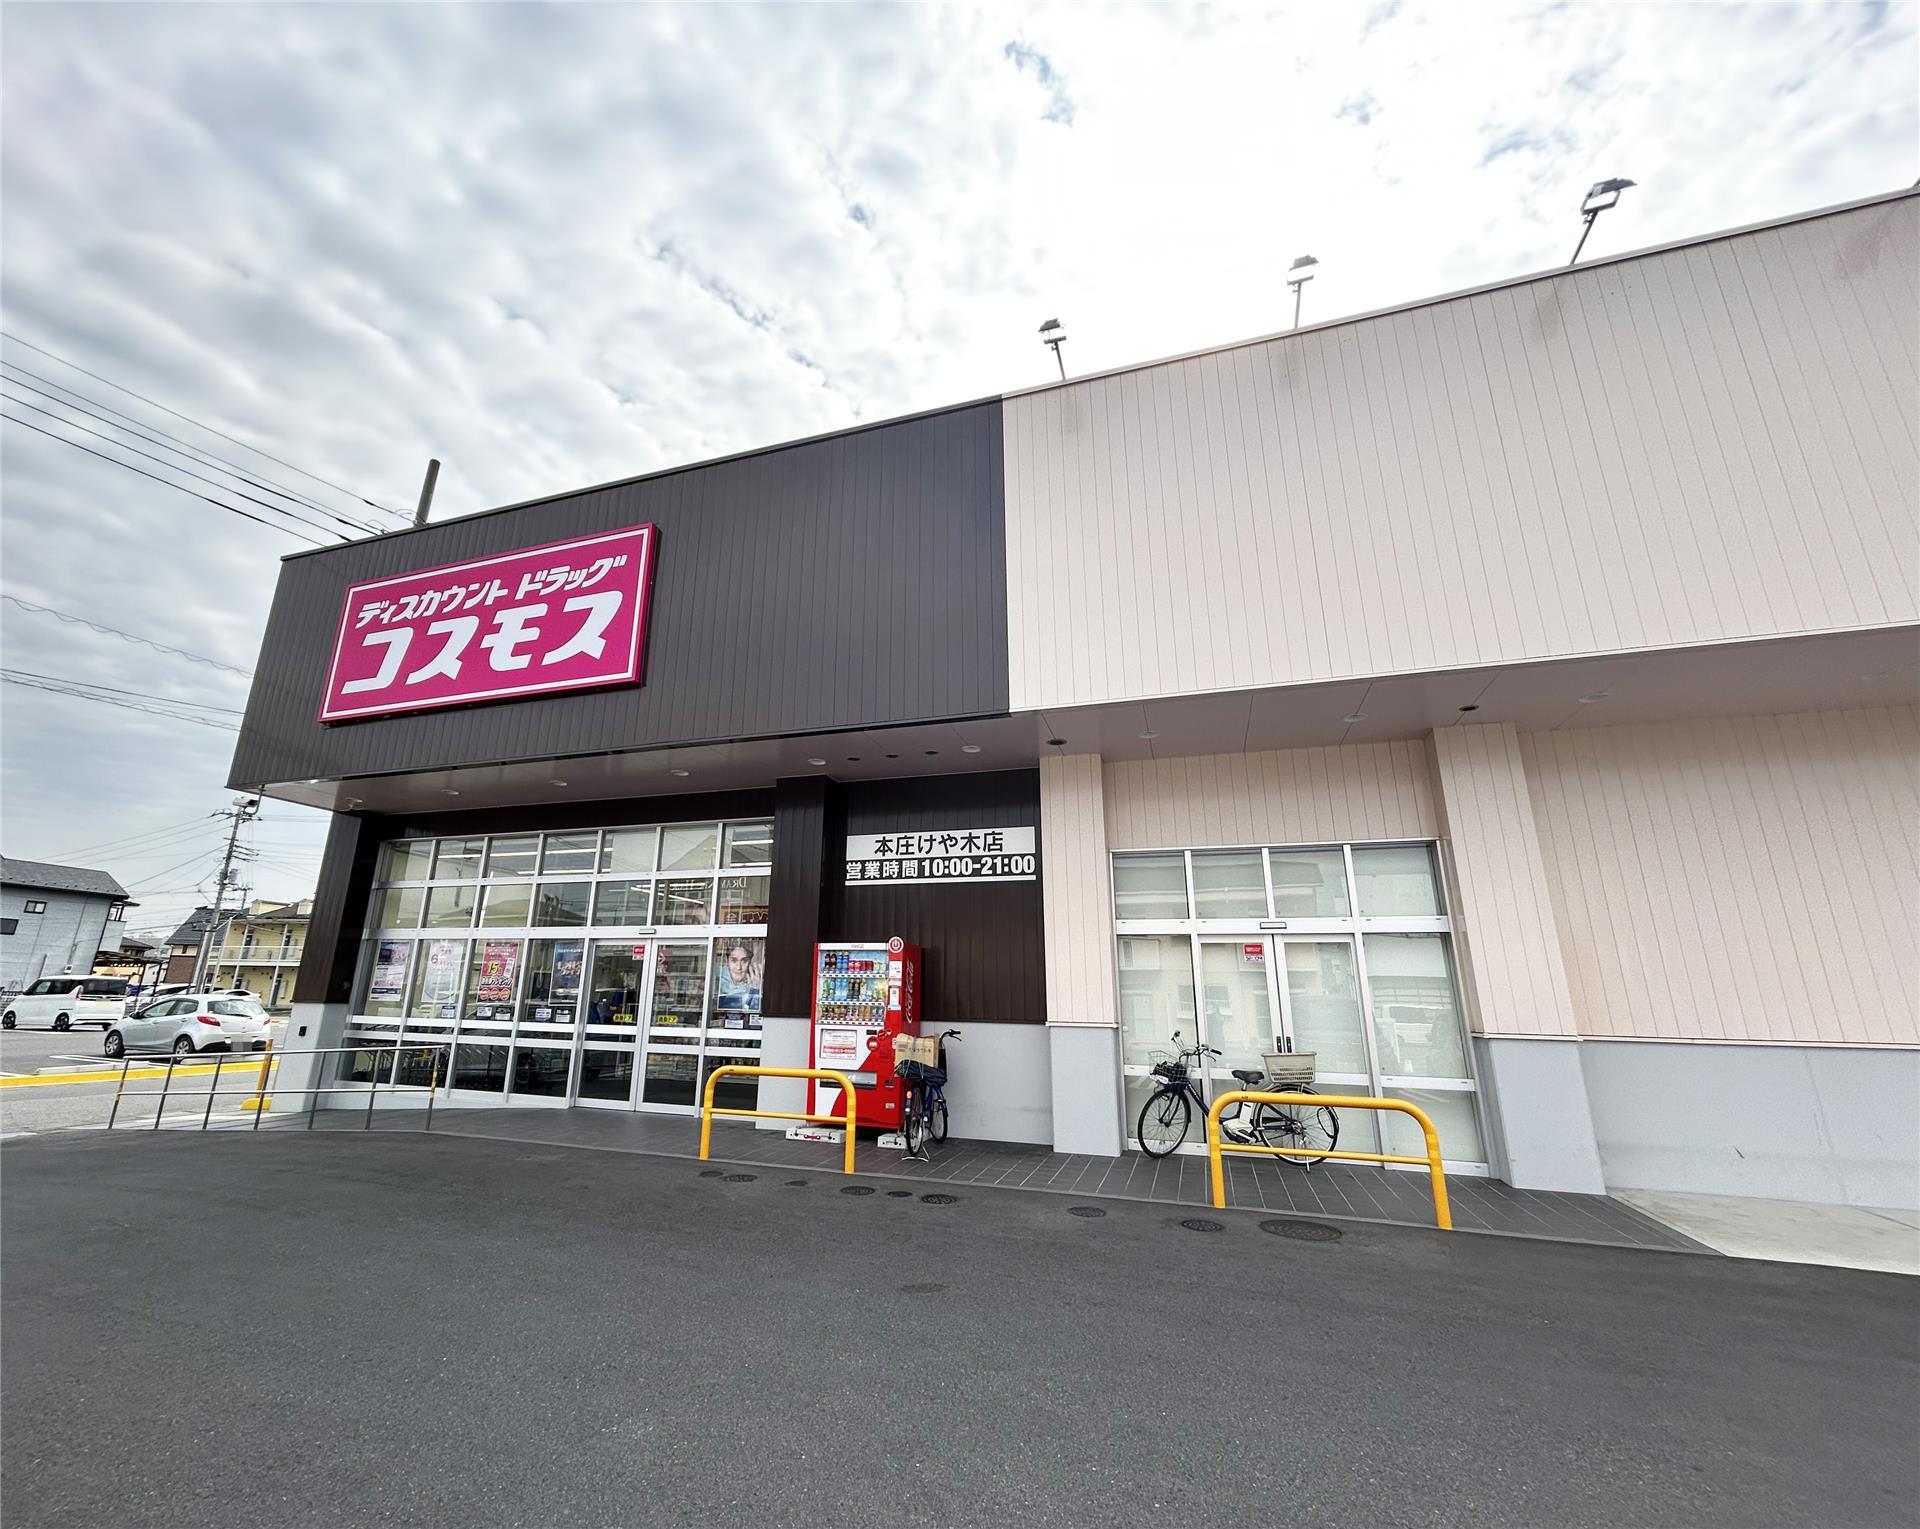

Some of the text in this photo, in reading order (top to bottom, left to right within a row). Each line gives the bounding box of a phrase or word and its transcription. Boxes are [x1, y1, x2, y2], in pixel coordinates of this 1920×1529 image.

[354, 554, 628, 629] ディスカウント ドラッグ
[340, 590, 624, 695] コスモス
[846, 855, 1036, 880] 営業時間 10:00-21:00
[874, 831, 1004, 857] 本庄けや木店
